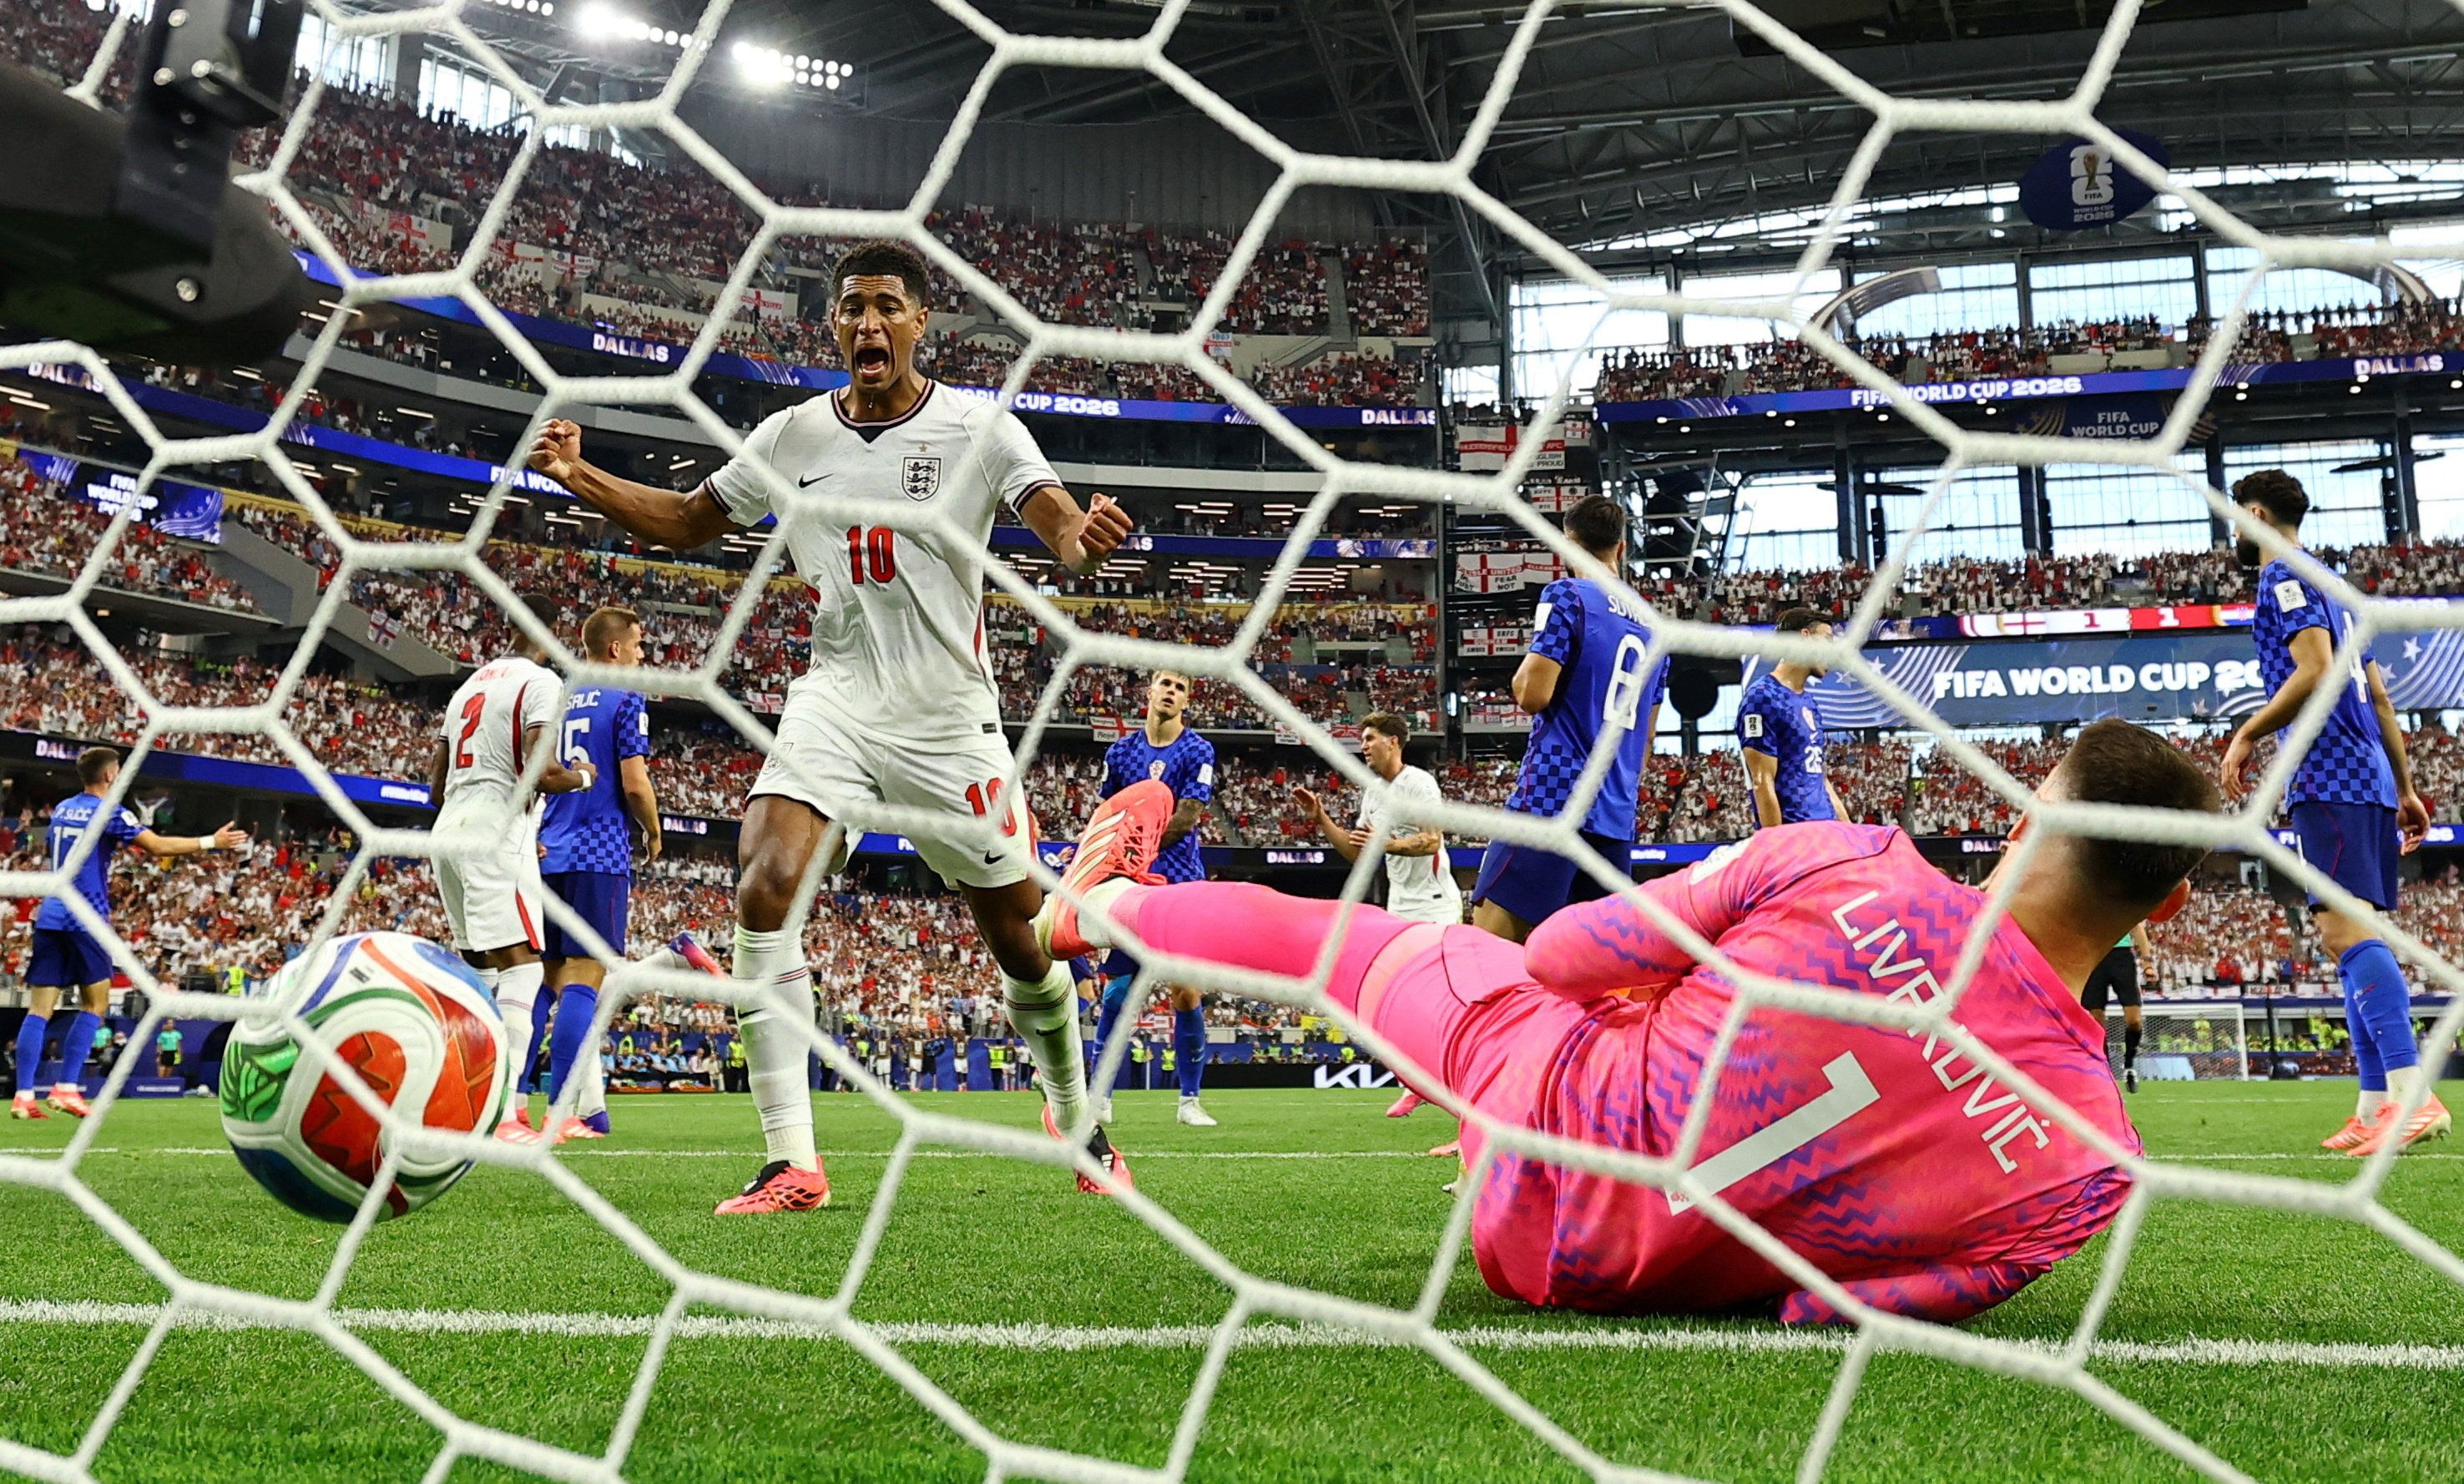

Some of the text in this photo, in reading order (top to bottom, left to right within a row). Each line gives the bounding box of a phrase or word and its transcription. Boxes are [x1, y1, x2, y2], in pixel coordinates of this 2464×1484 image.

[2073, 210, 2114, 222] 2026
[593, 333, 669, 362] DALLAS
[2354, 355, 2444, 375] DALLAS
[1851, 377, 2082, 406] FIFA WORLD CUP 2026
[1015, 393, 1053, 410] CUP
[1054, 396, 1119, 416] 2026
[1361, 409, 1435, 425] DALLAS
[2098, 411, 2130, 423] FIFA
[2072, 421, 2159, 437] WORLD CUP
[87, 483, 132, 505] WORLD
[846, 525, 896, 584] 10
[2083, 607, 2179, 628] 1 1
[1933, 659, 2264, 699] FIFA WORLD CUP 20
[456, 693, 486, 769] 2
[555, 717, 590, 765] 15
[36, 739, 86, 760] DALL
[965, 777, 1017, 837] 10
[663, 817, 708, 835] DALLAS
[53, 825, 86, 873] 17
[1267, 851, 1325, 863] DALLAS
[1962, 840, 2000, 853] DALL
[1664, 1050, 1881, 1216] 1
